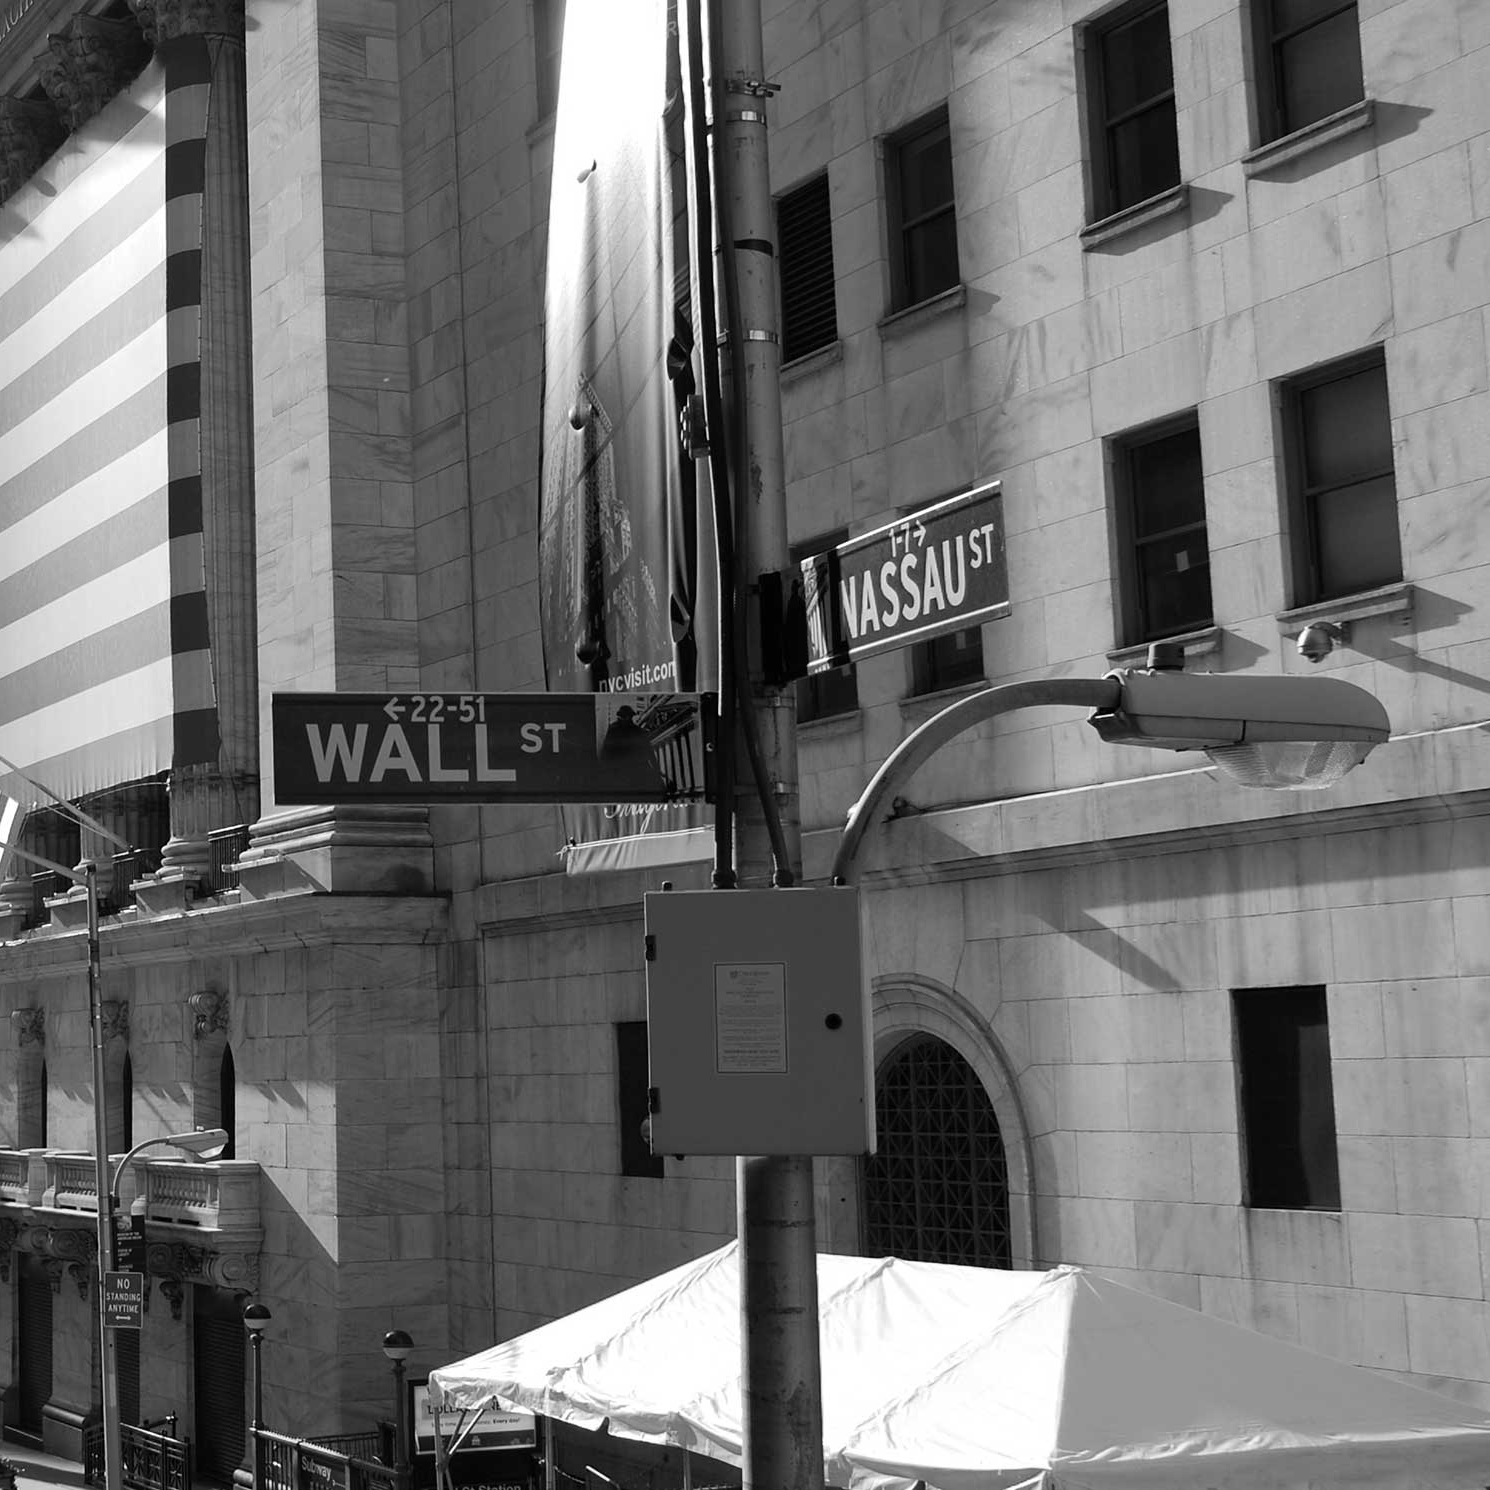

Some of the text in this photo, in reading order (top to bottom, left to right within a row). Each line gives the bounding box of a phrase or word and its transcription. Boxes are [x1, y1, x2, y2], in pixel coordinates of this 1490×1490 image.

[841, 523, 994, 639] NASSAU ST
[410, 695, 486, 723] 22-51
[306, 723, 567, 783] WALL ST
[105, 1292, 141, 1302] STANDING
[116, 1278, 130, 1290] NO
[107, 1303, 139, 1313] ANYTIME
[301, 1455, 332, 1482] Subway
